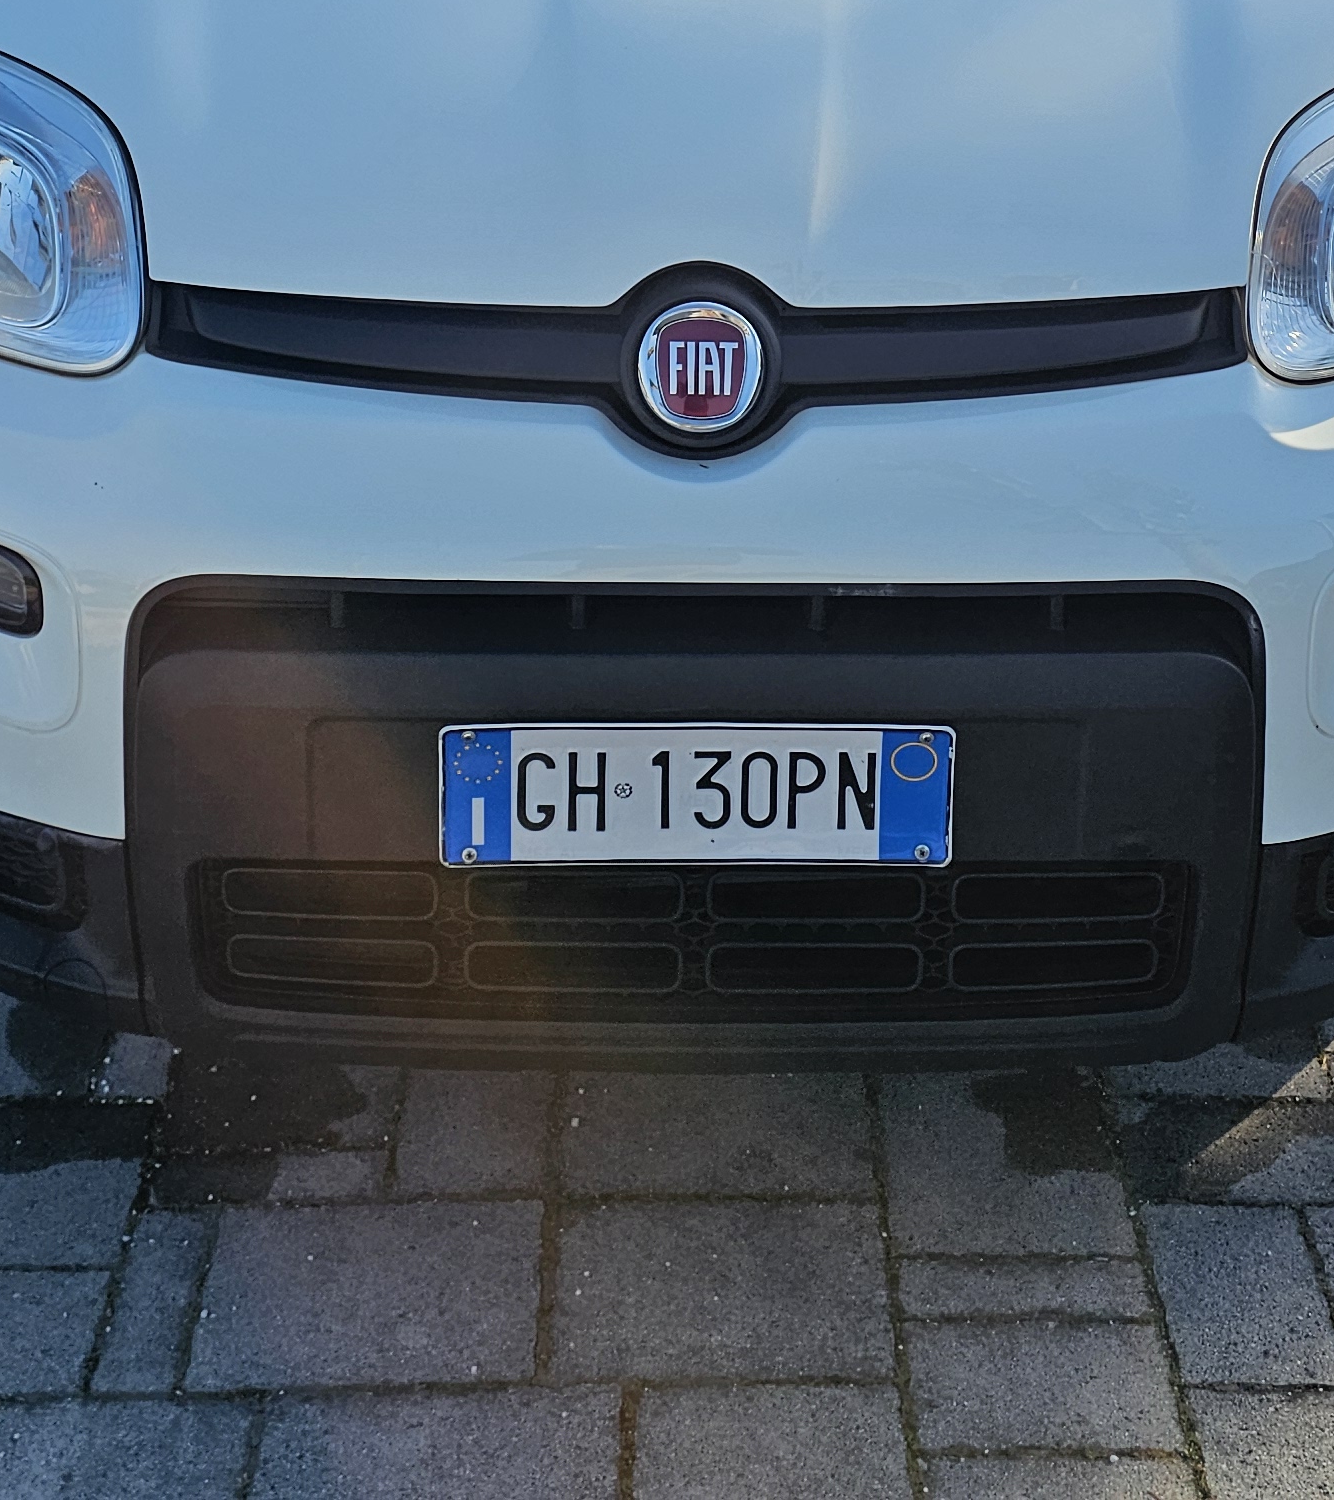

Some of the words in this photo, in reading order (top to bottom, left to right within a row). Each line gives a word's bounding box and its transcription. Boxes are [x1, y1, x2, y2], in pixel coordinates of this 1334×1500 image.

[669, 340, 739, 396] FIAT
[516, 751, 607, 832] GH
[651, 750, 877, 831] 130PN
